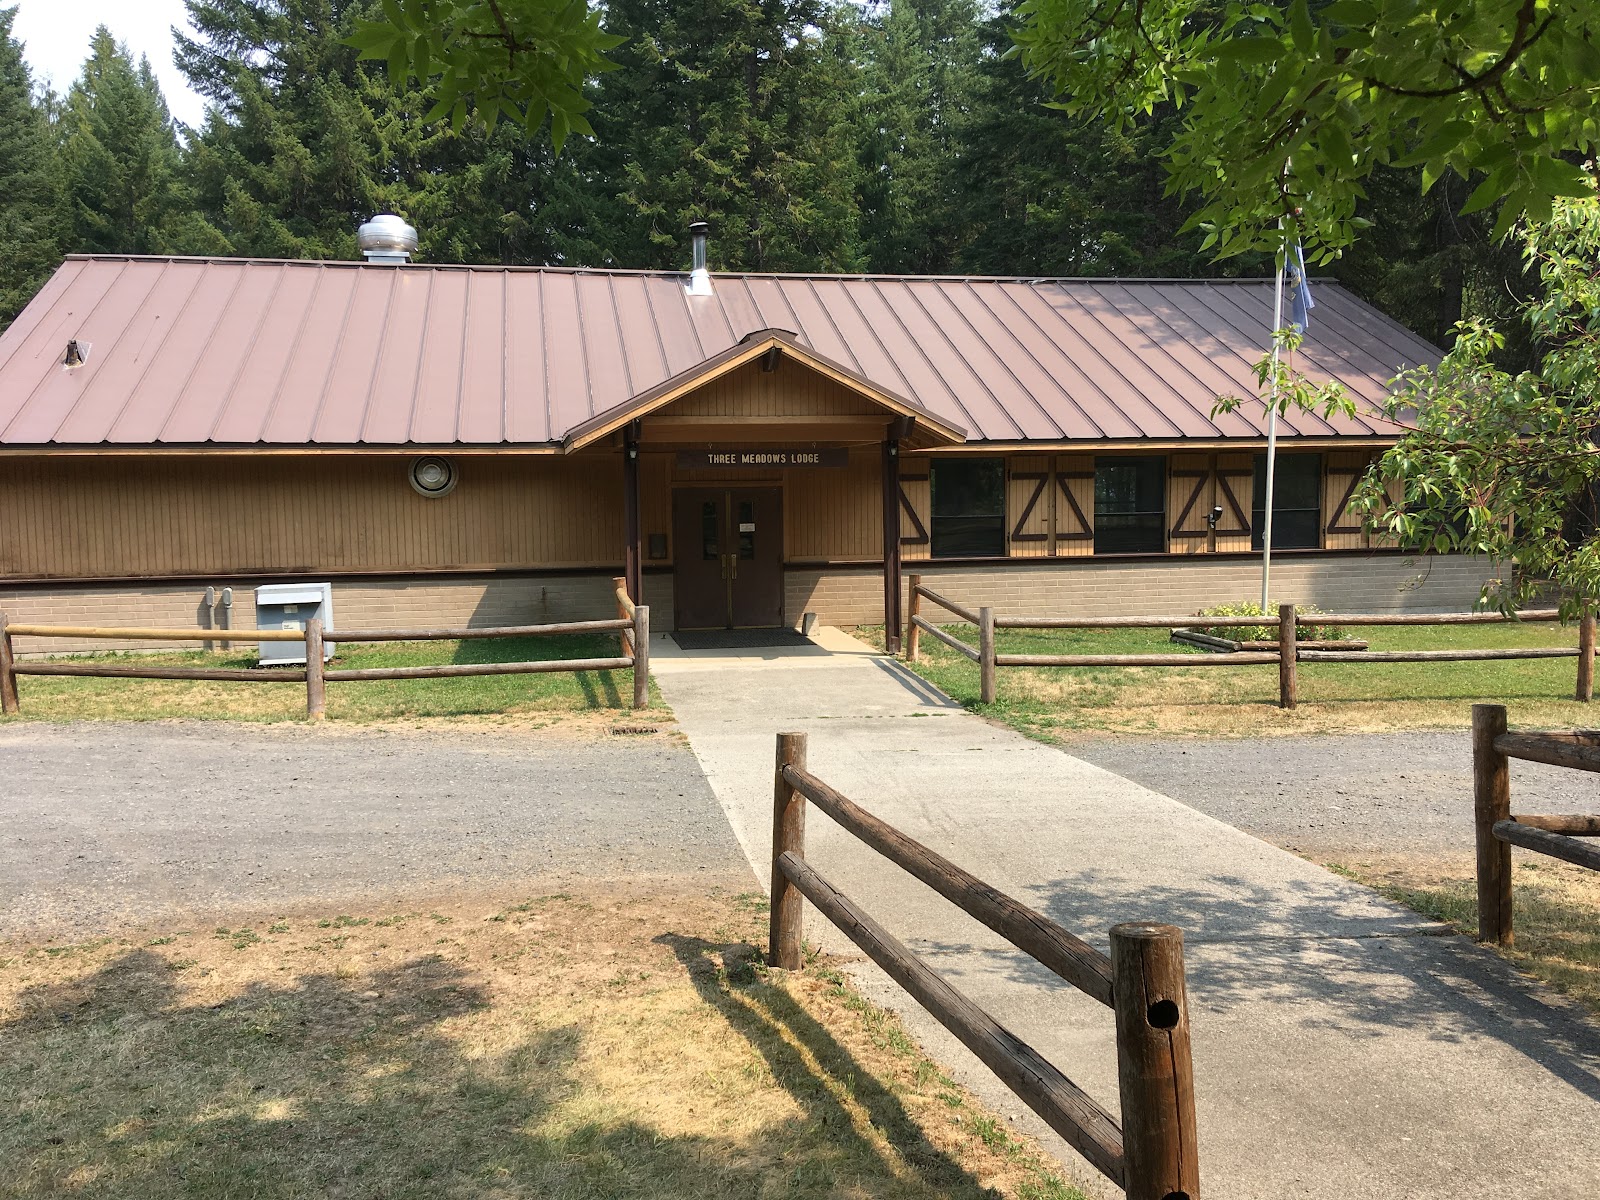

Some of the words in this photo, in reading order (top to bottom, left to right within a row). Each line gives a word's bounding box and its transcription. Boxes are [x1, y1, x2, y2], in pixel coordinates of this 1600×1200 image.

[708, 454, 736, 464] THREE
[741, 454, 786, 463] MEADOWS
[791, 453, 819, 463] LODGE
